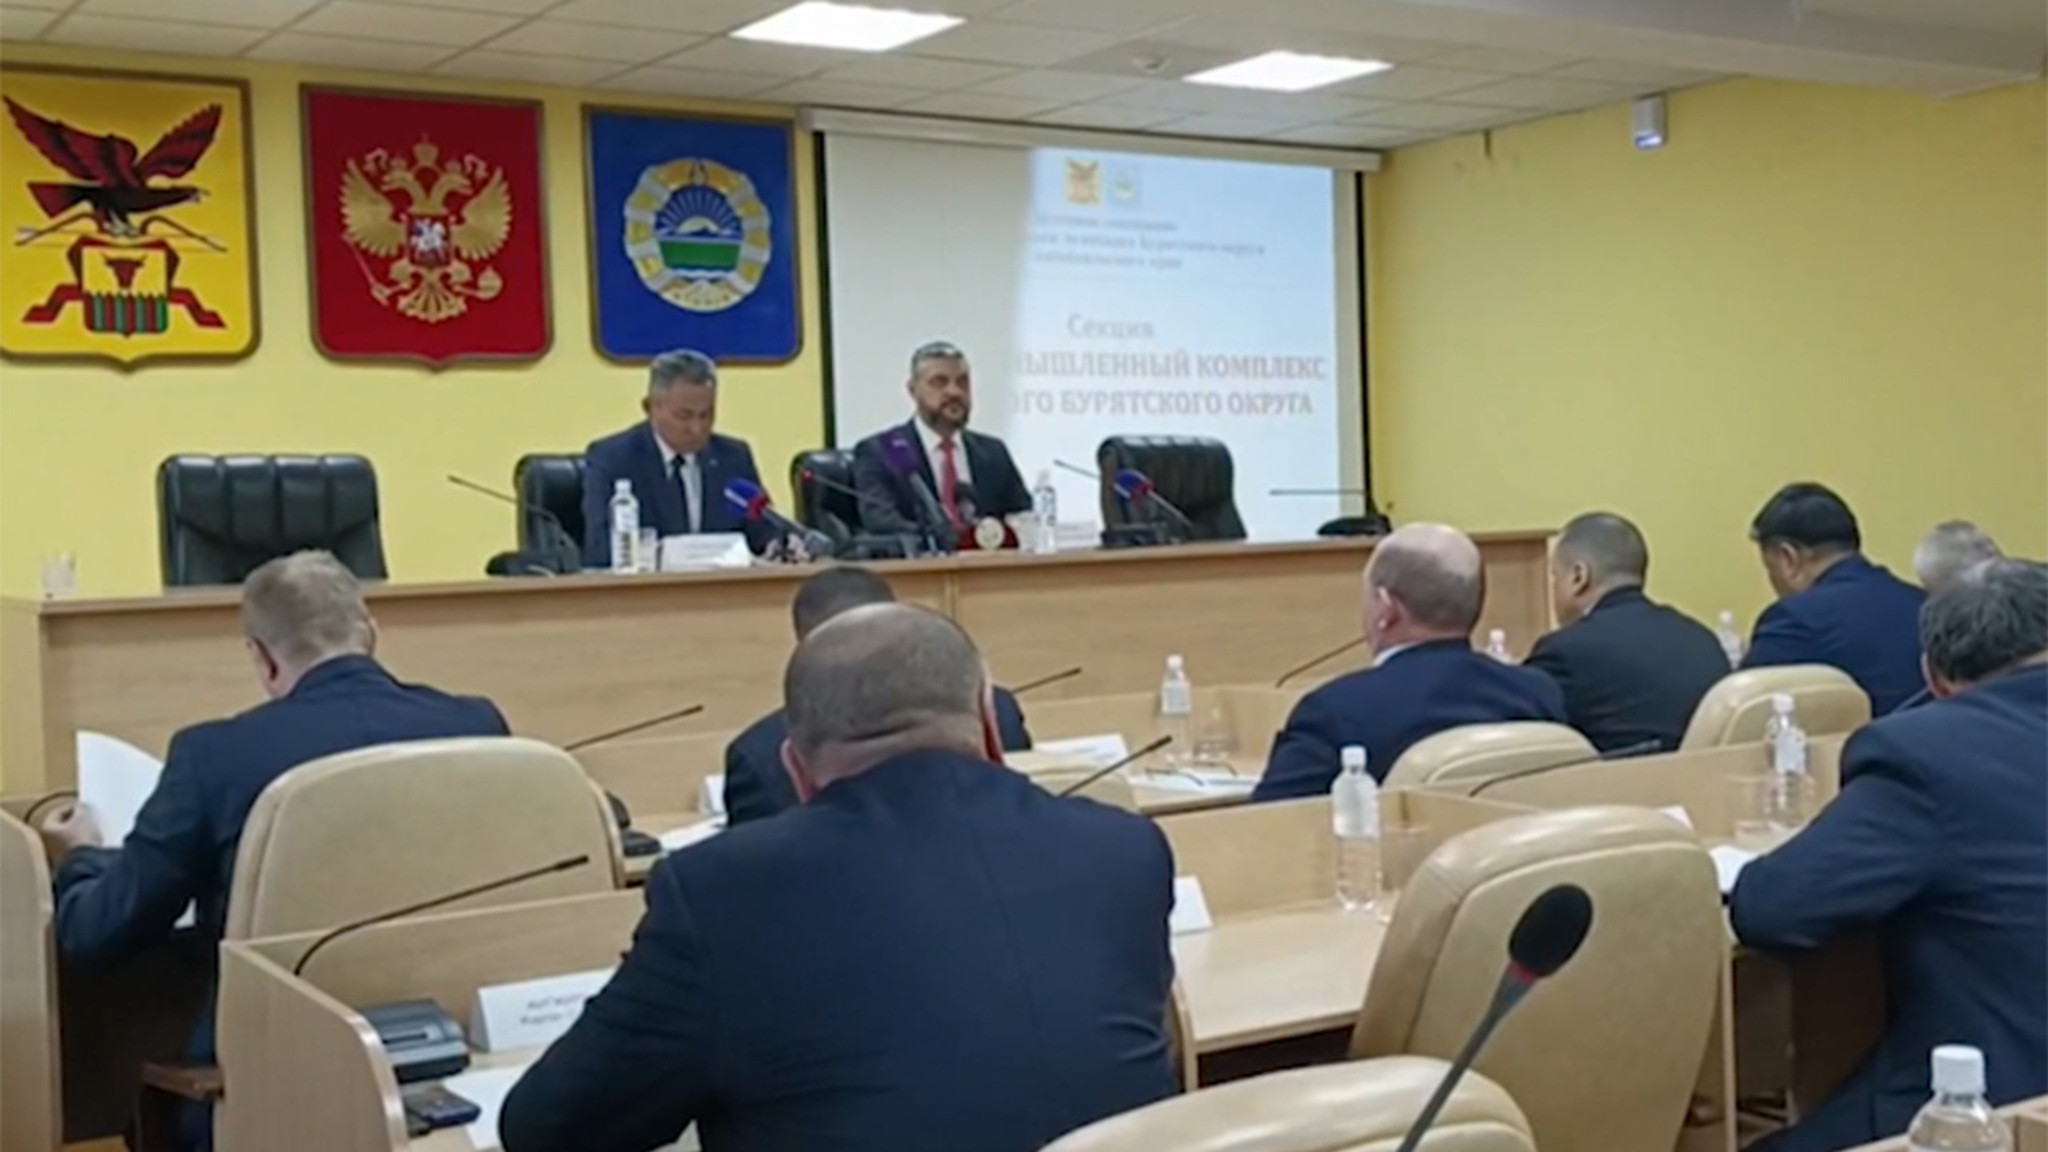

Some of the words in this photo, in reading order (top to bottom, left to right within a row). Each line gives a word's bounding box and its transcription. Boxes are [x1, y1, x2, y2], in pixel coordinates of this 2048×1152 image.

[1198, 354, 1327, 380] КОМПЛЕКС
[1060, 390, 1222, 416] БУРЯТСКОГО
[1227, 391, 1314, 416] ОКРУГА
